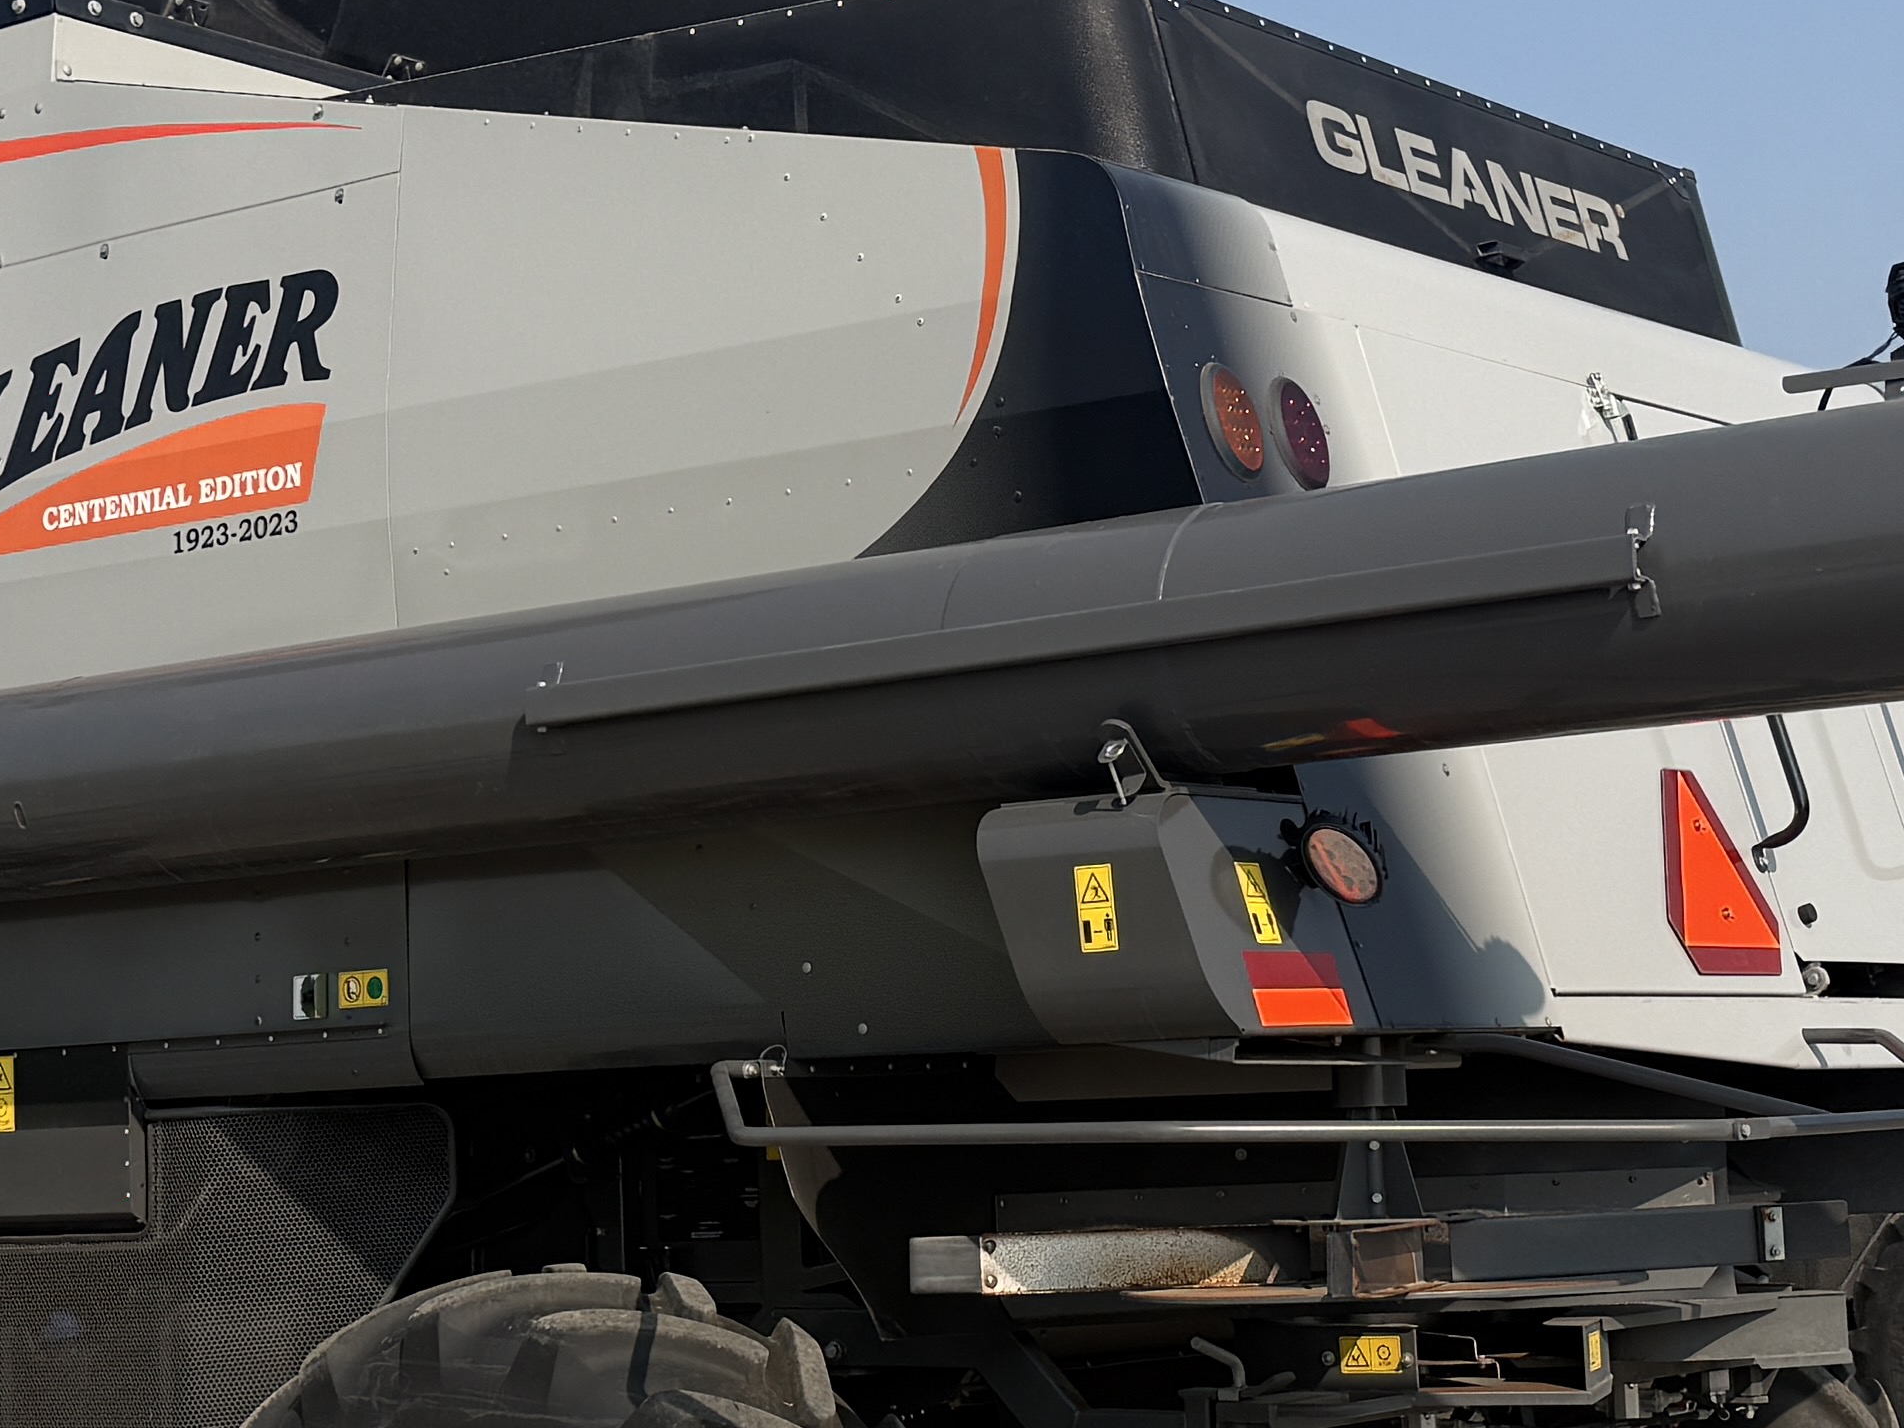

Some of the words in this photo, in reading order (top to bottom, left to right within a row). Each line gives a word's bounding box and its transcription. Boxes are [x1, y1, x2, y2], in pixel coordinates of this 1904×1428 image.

[1306, 99, 1628, 261] GLEANER
[42, 482, 192, 532] CENTENNIAL
[198, 462, 303, 504] EDITION
[173, 510, 299, 555] 1923-2023
